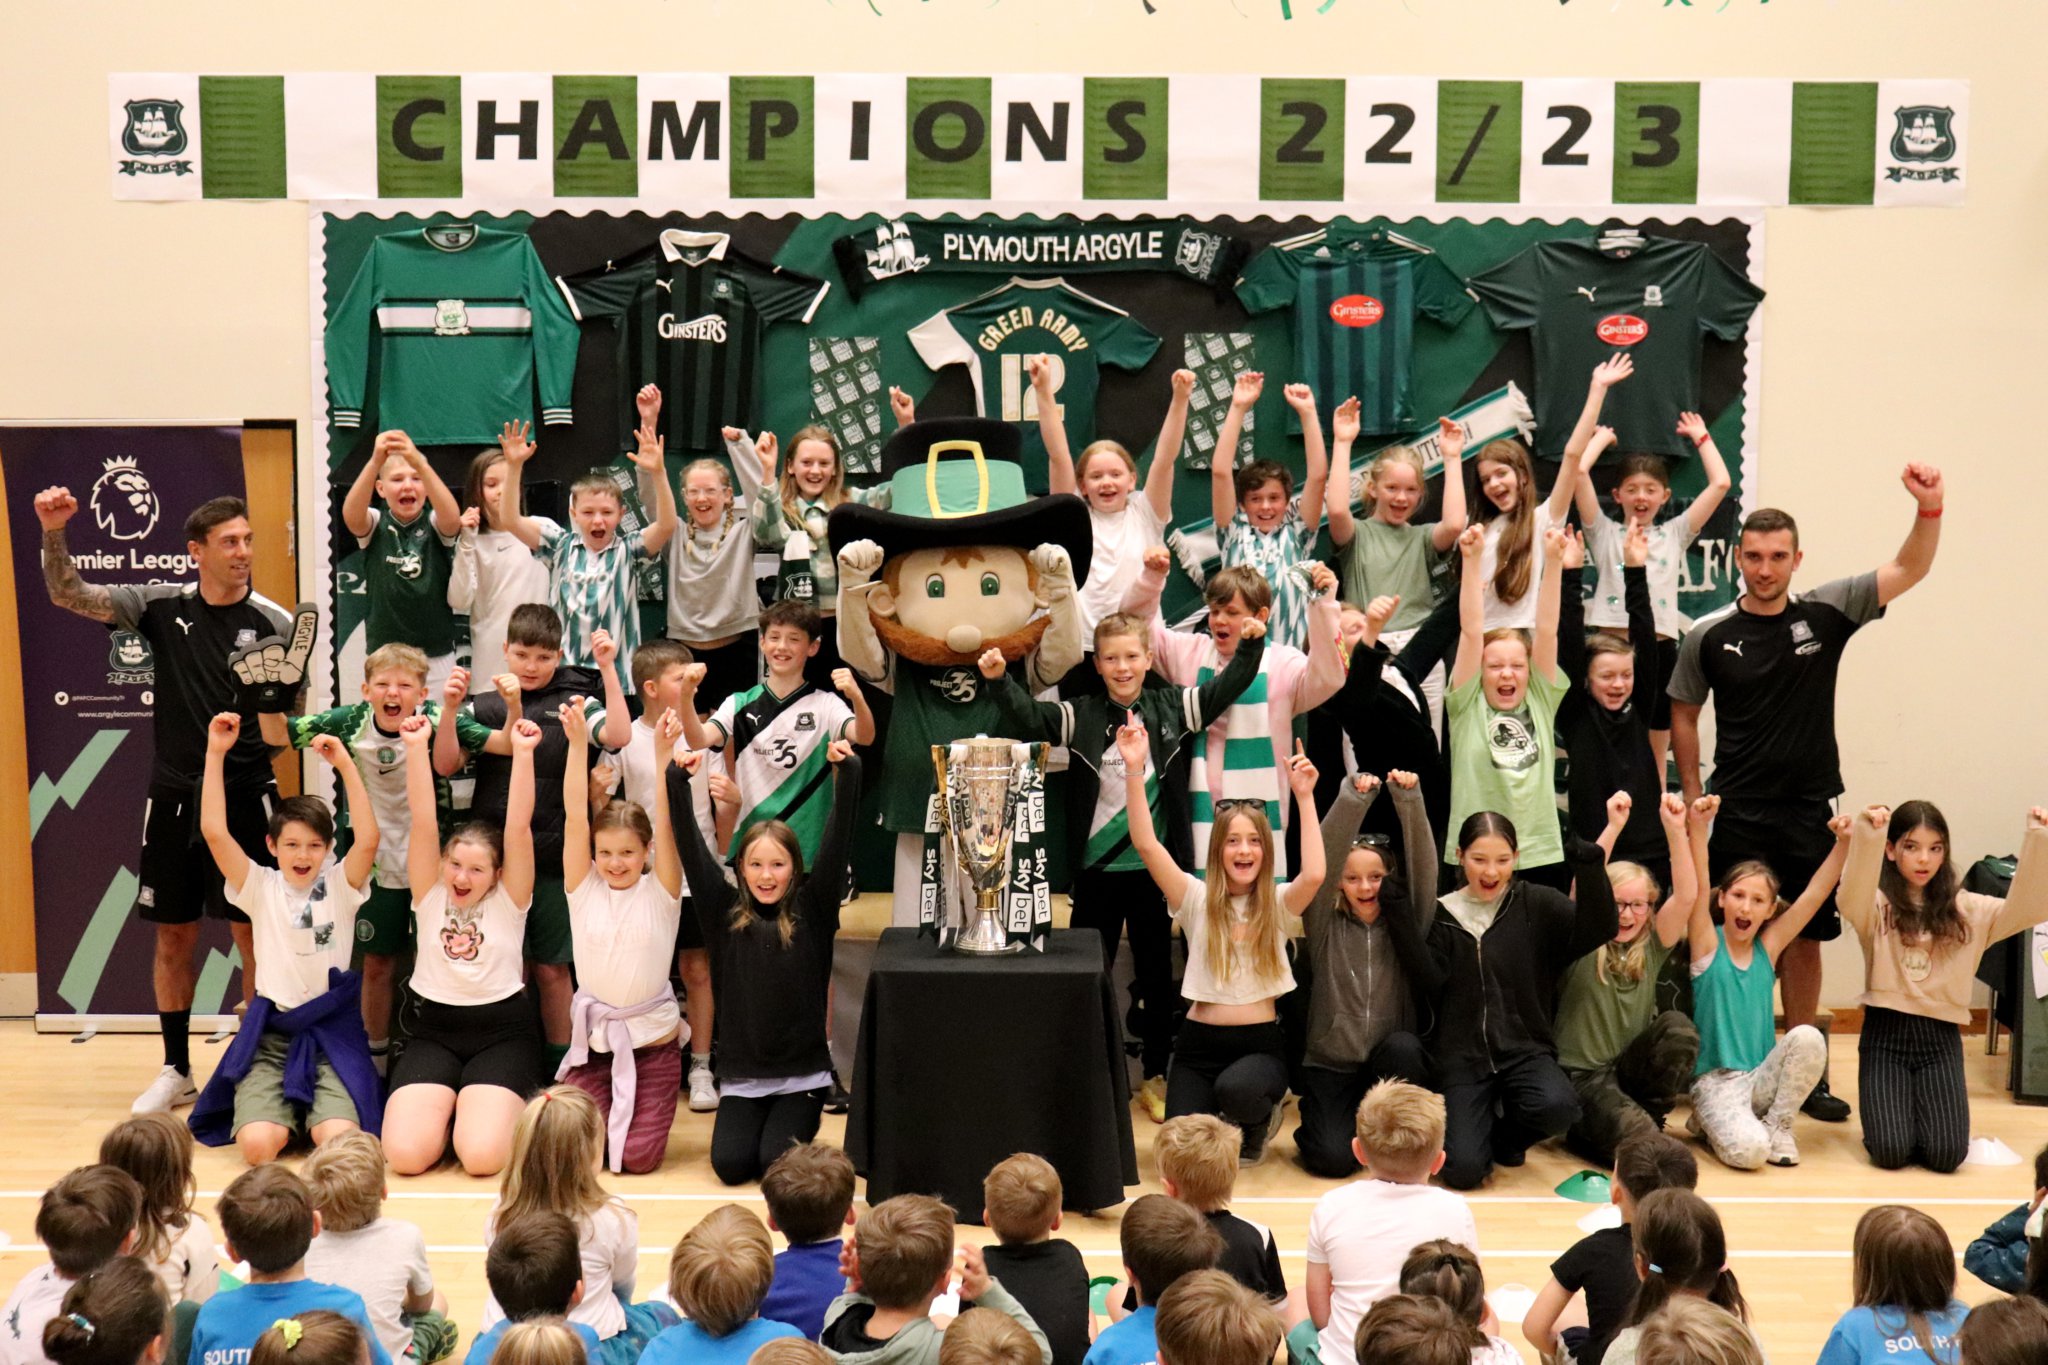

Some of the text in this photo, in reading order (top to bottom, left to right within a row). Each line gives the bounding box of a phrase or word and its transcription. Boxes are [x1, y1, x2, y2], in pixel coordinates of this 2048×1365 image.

[391, 97, 1681, 186] CHAMPIONS 22/23
[943, 231, 1164, 263] PLYMOUTH ARGYLE
[658, 313, 727, 343] GINSTERS
[978, 306, 1089, 352] GREEN ARMY
[1001, 353, 1065, 421] 12
[130, 548, 200, 575] Leagu
[294, 615, 315, 652] ARGYLE
[77, 710, 154, 719] www.argylecommuni
[930, 798, 941, 828] bet
[1033, 796, 1045, 828] bet
[923, 848, 938, 919] sky bet
[1013, 858, 1031, 928] sky bet
[1032, 848, 1048, 919] sky bet
[1875, 1335, 1951, 1354] SOUH
